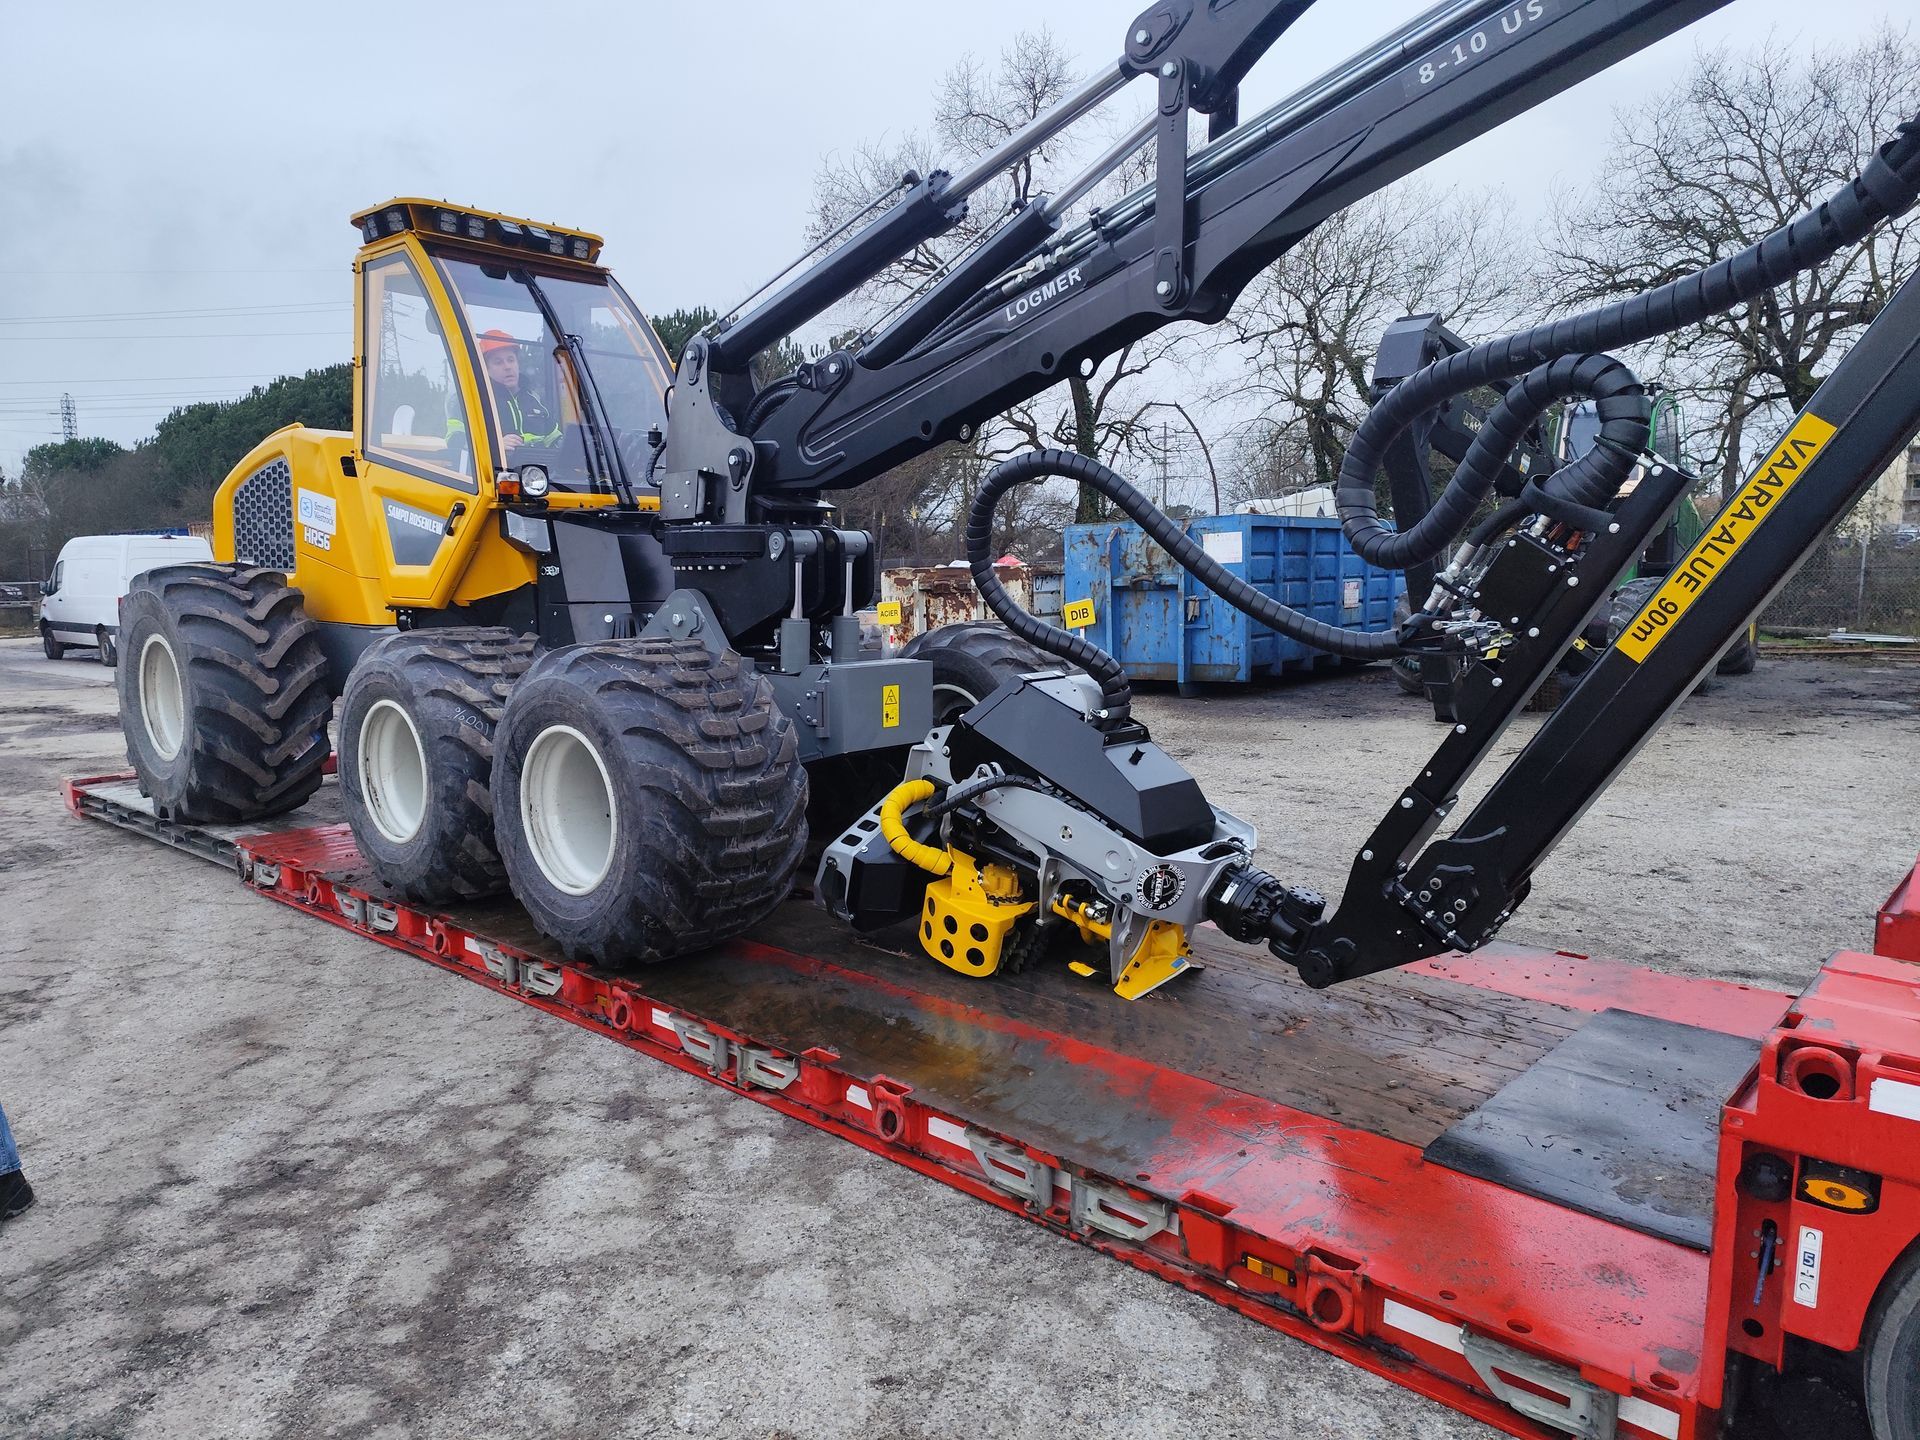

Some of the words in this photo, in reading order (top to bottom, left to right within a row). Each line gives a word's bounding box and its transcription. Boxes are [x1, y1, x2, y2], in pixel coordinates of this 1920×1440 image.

[1418, 31, 1487, 85] 8-10
[1500, 0, 1544, 35] US
[1005, 267, 1082, 322] LOGMER
[387, 504, 410, 523] SAMPO
[409, 512, 444, 536] ROSENLEW
[1675, 438, 1817, 593] VAARA-ALUE
[880, 609, 899, 618] ACIER
[1070, 607, 1089, 621] DIB
[1631, 597, 1679, 643] 90m
[1153, 877, 1164, 903] KESLA
